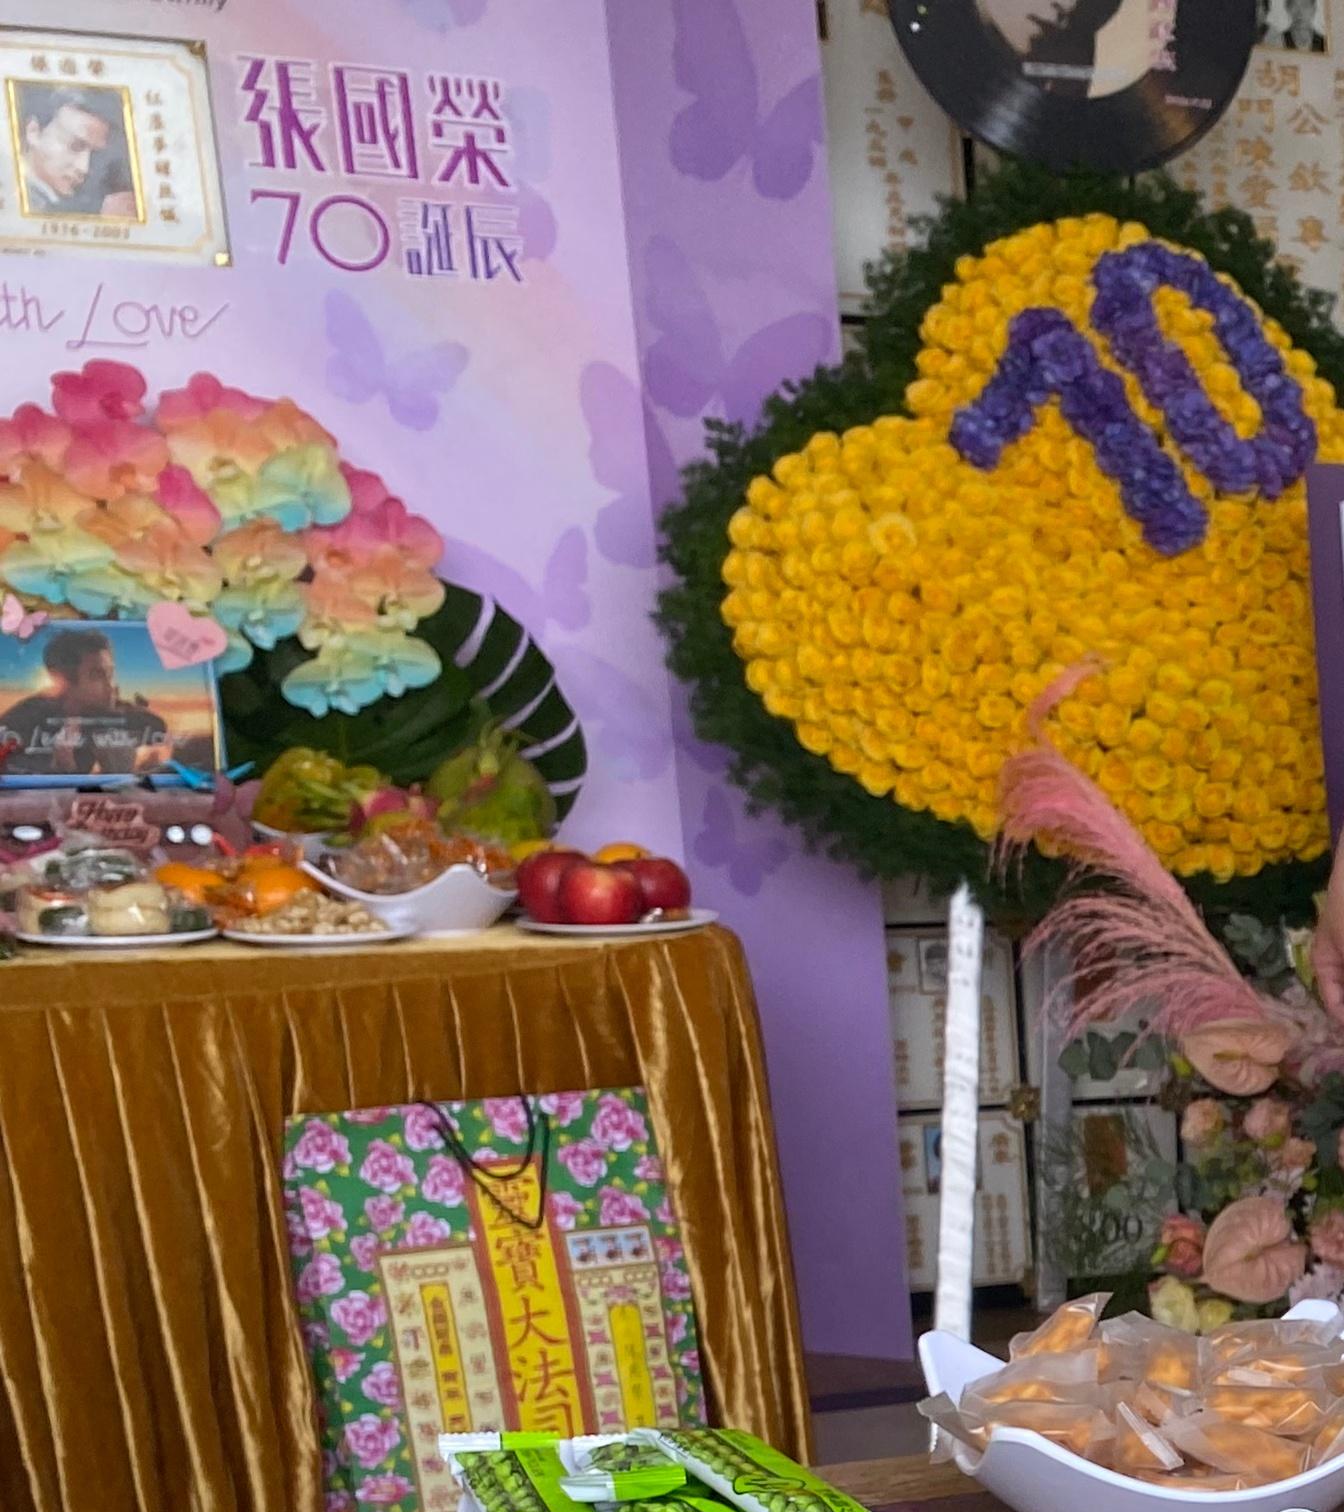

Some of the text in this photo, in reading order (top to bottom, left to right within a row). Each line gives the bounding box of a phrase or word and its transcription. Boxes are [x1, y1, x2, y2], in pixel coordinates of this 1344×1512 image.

[237, 54, 509, 188] 張國榮
[0, 281, 230, 350] th Love
[950, 240, 1317, 557] 70
